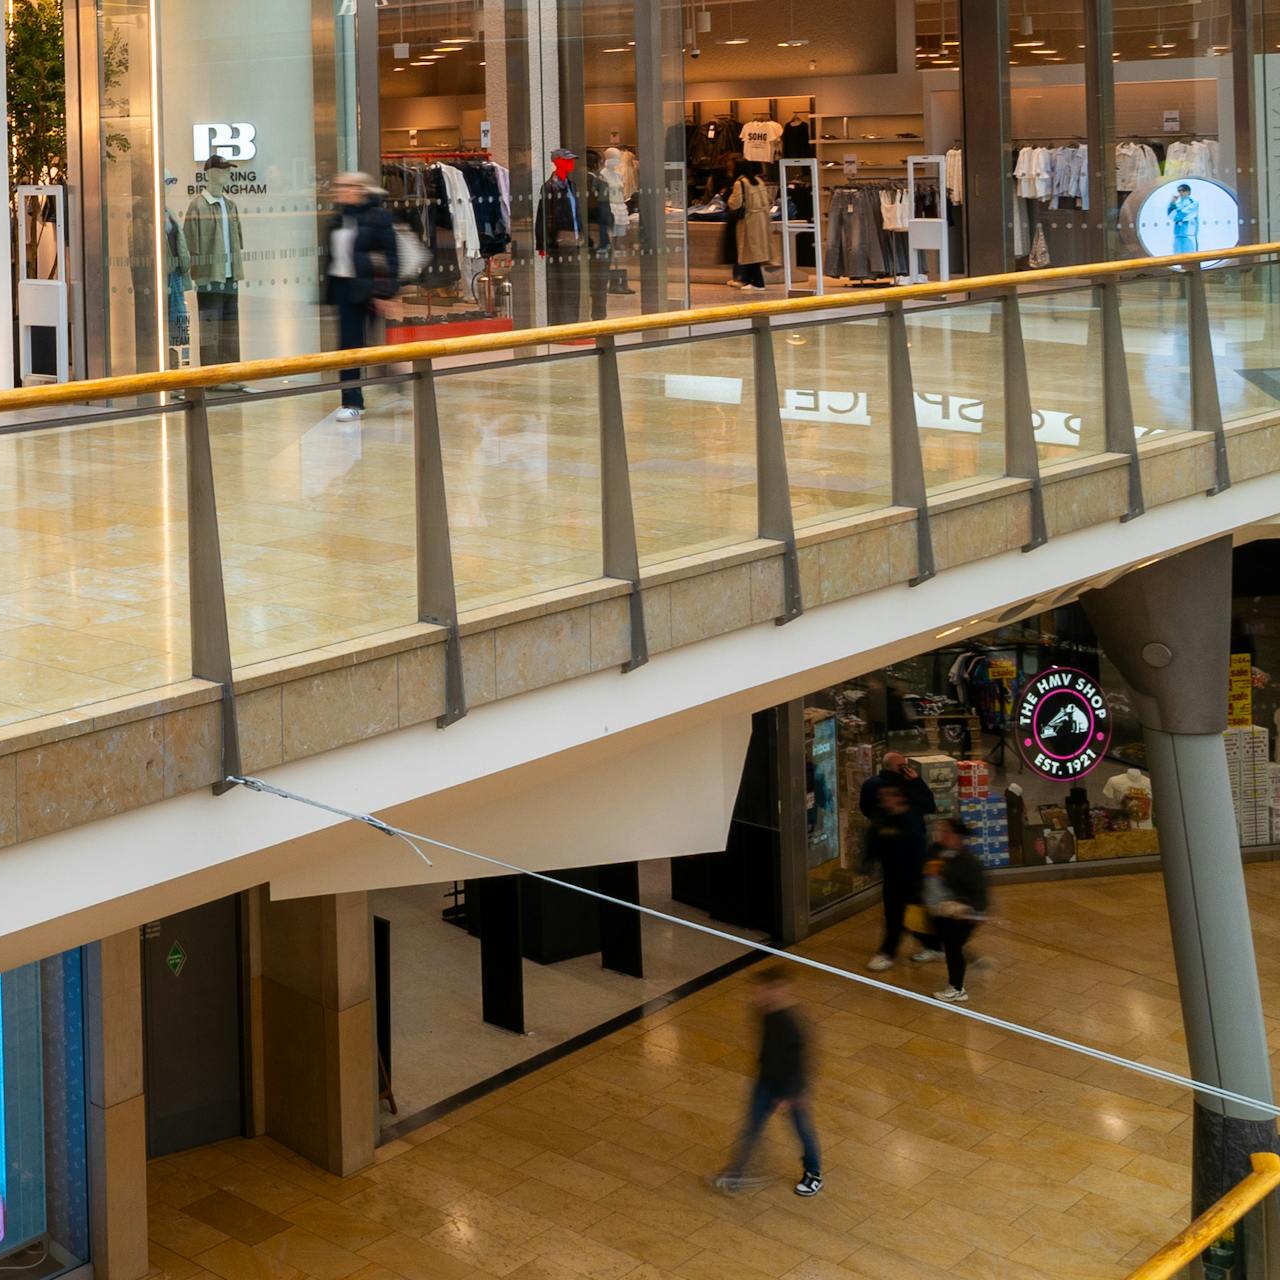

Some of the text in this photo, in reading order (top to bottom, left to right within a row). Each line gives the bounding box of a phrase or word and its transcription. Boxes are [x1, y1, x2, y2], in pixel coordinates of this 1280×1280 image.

[195, 171, 257, 182] BURING
[187, 184, 267, 195] BIRNGHAM
[1020, 673, 1107, 725] THE HMV SHOP
[1034, 748, 1097, 775] EST. 1921
